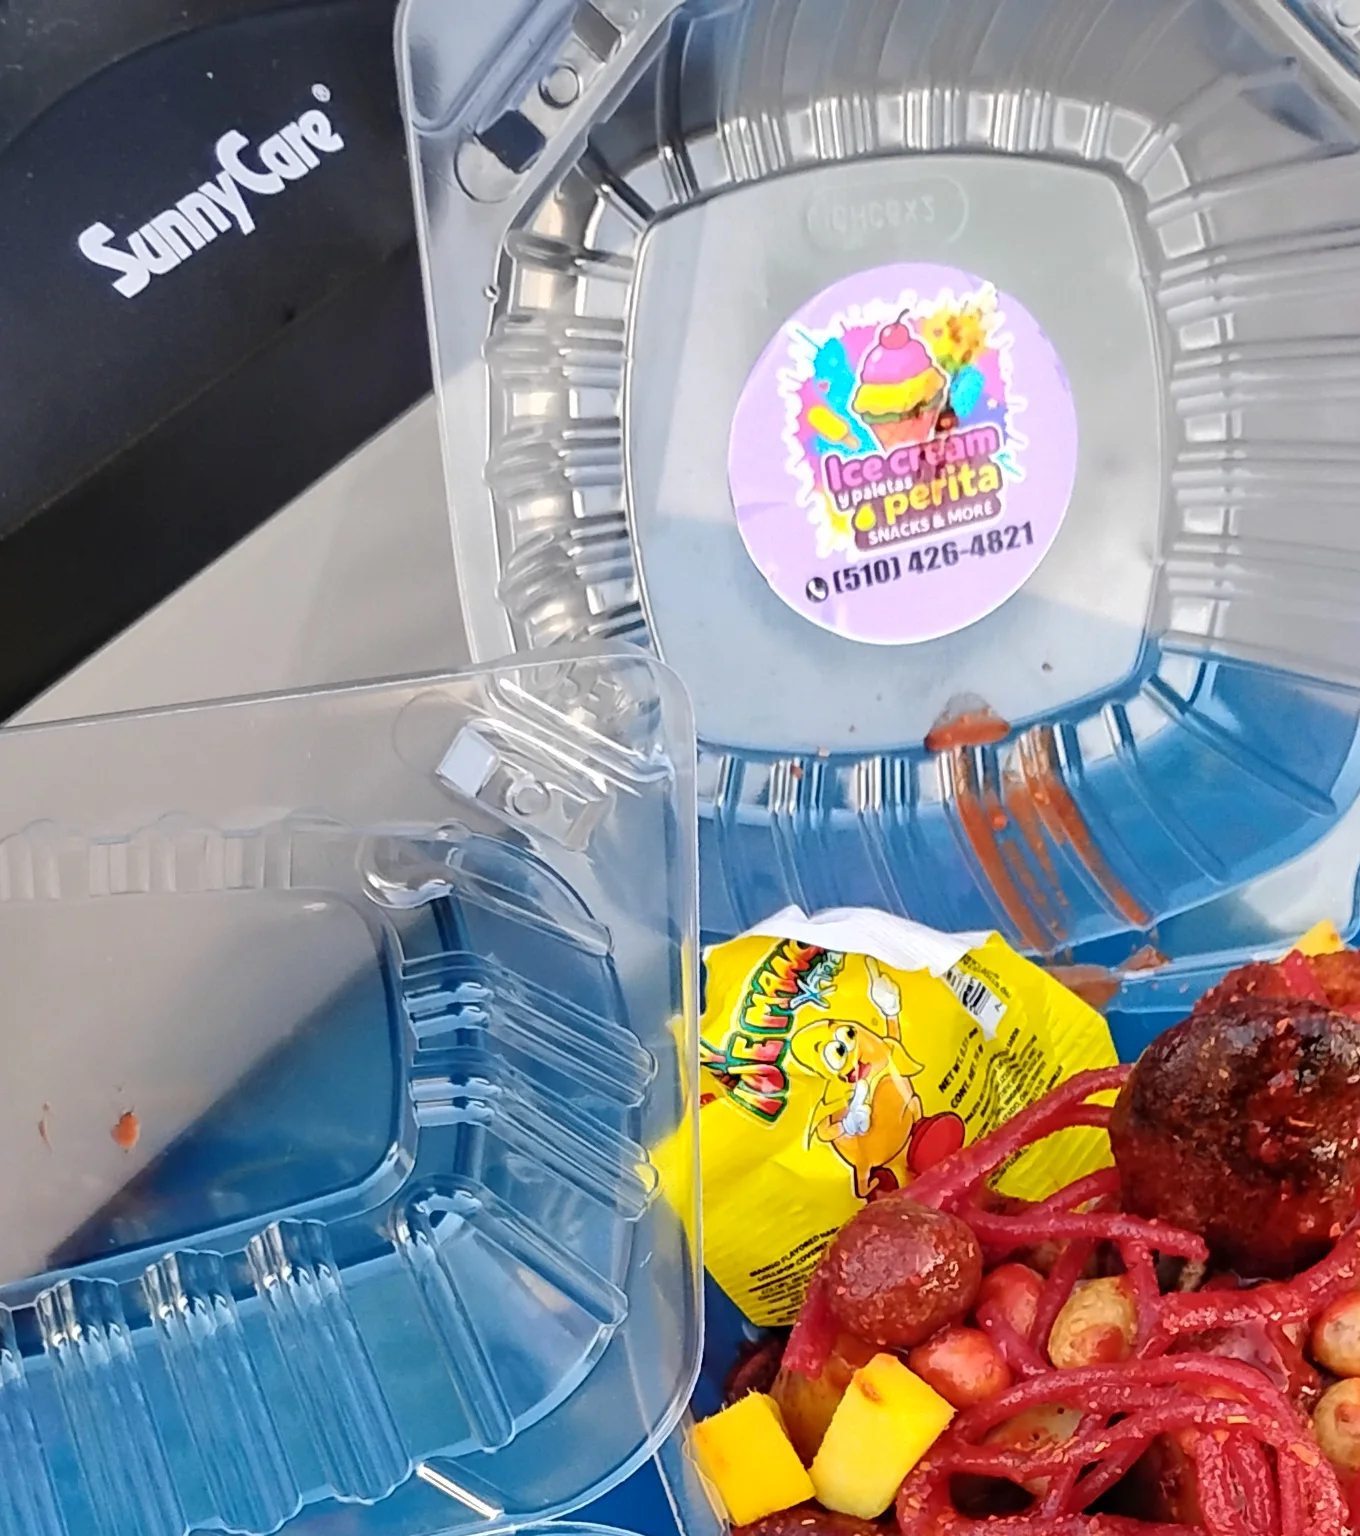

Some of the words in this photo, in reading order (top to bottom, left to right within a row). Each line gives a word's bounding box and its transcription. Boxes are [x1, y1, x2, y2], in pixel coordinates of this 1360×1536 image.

[828, 456, 883, 491] Ice
[891, 428, 998, 474] cream
[852, 476, 913, 506] paletas
[884, 463, 999, 526] perita
[868, 519, 930, 546] SNACKS
[932, 514, 946, 529] &
[948, 500, 993, 527] MORE
[833, 557, 902, 594] (510)
[908, 521, 1035, 574] 426-4821
[938, 1071, 955, 1093] NET
[781, 1235, 820, 1264] FLAVORED
